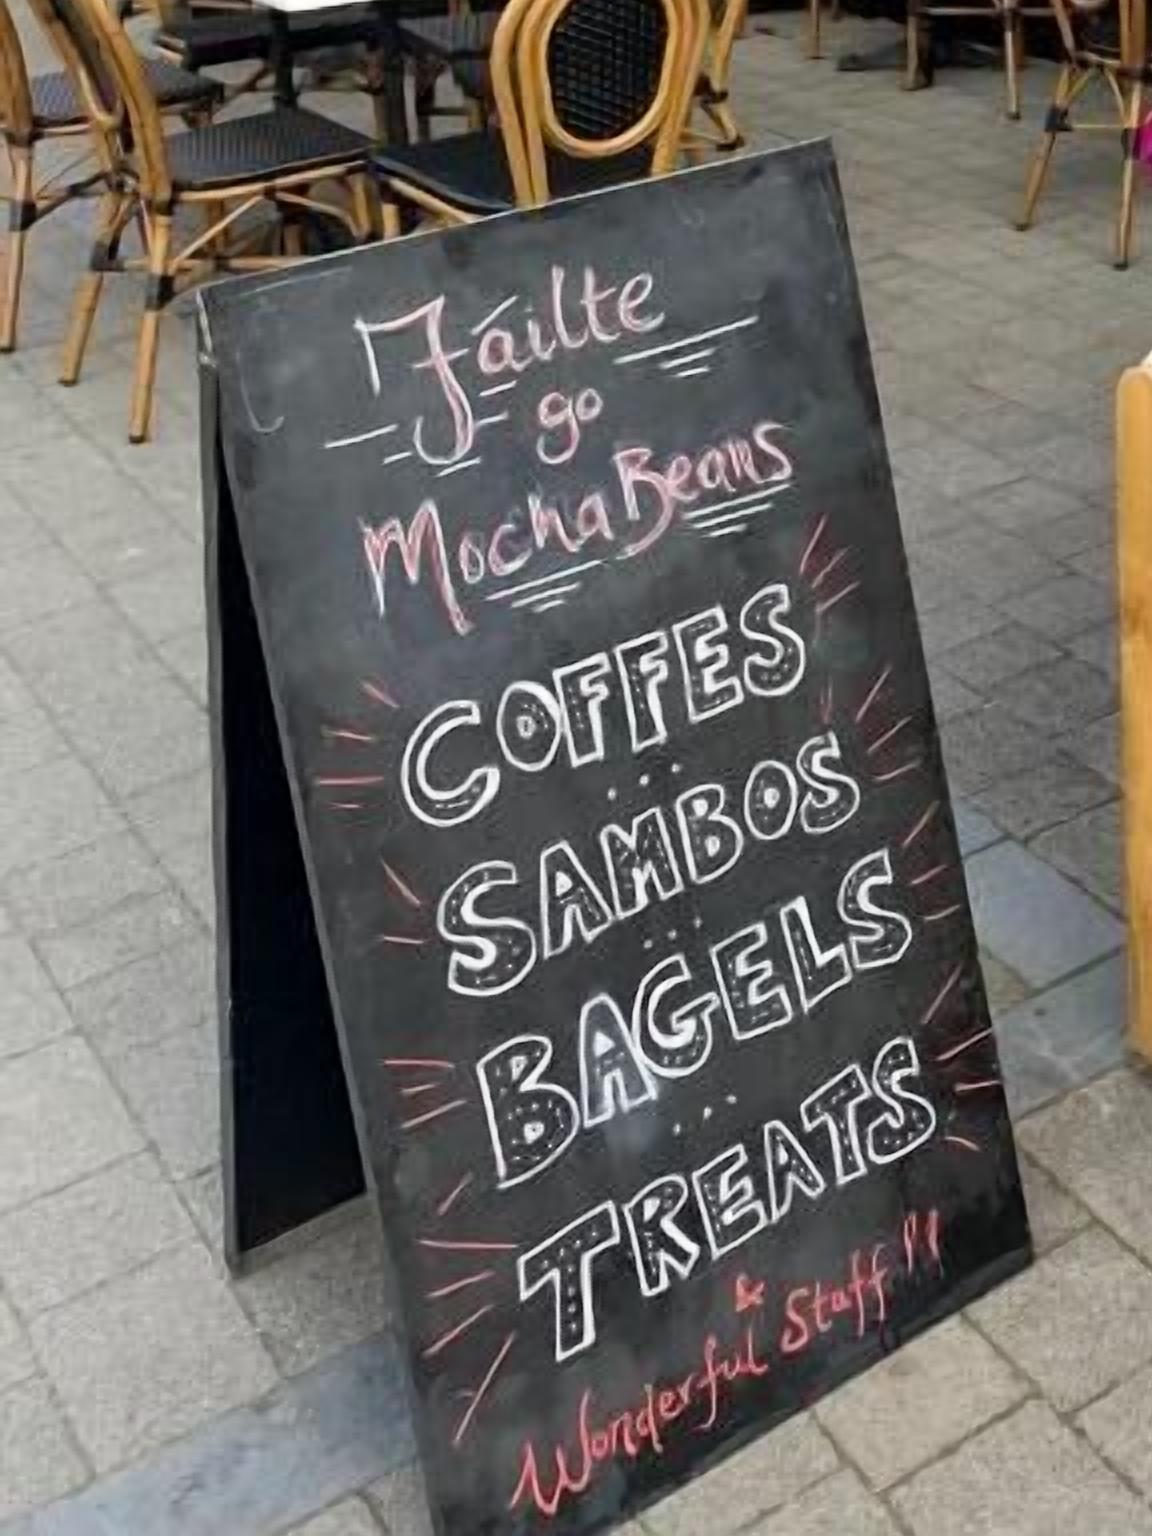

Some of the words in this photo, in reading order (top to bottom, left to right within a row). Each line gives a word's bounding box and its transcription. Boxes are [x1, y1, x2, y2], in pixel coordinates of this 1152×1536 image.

[536, 387, 603, 463] go
[401, 583, 805, 826] COFFES
[438, 731, 861, 997] SAMBOS
[477, 849, 912, 1187] BAGELS
[517, 1037, 936, 1361] TREATS
[510, 1326, 768, 1514] Wonderful
